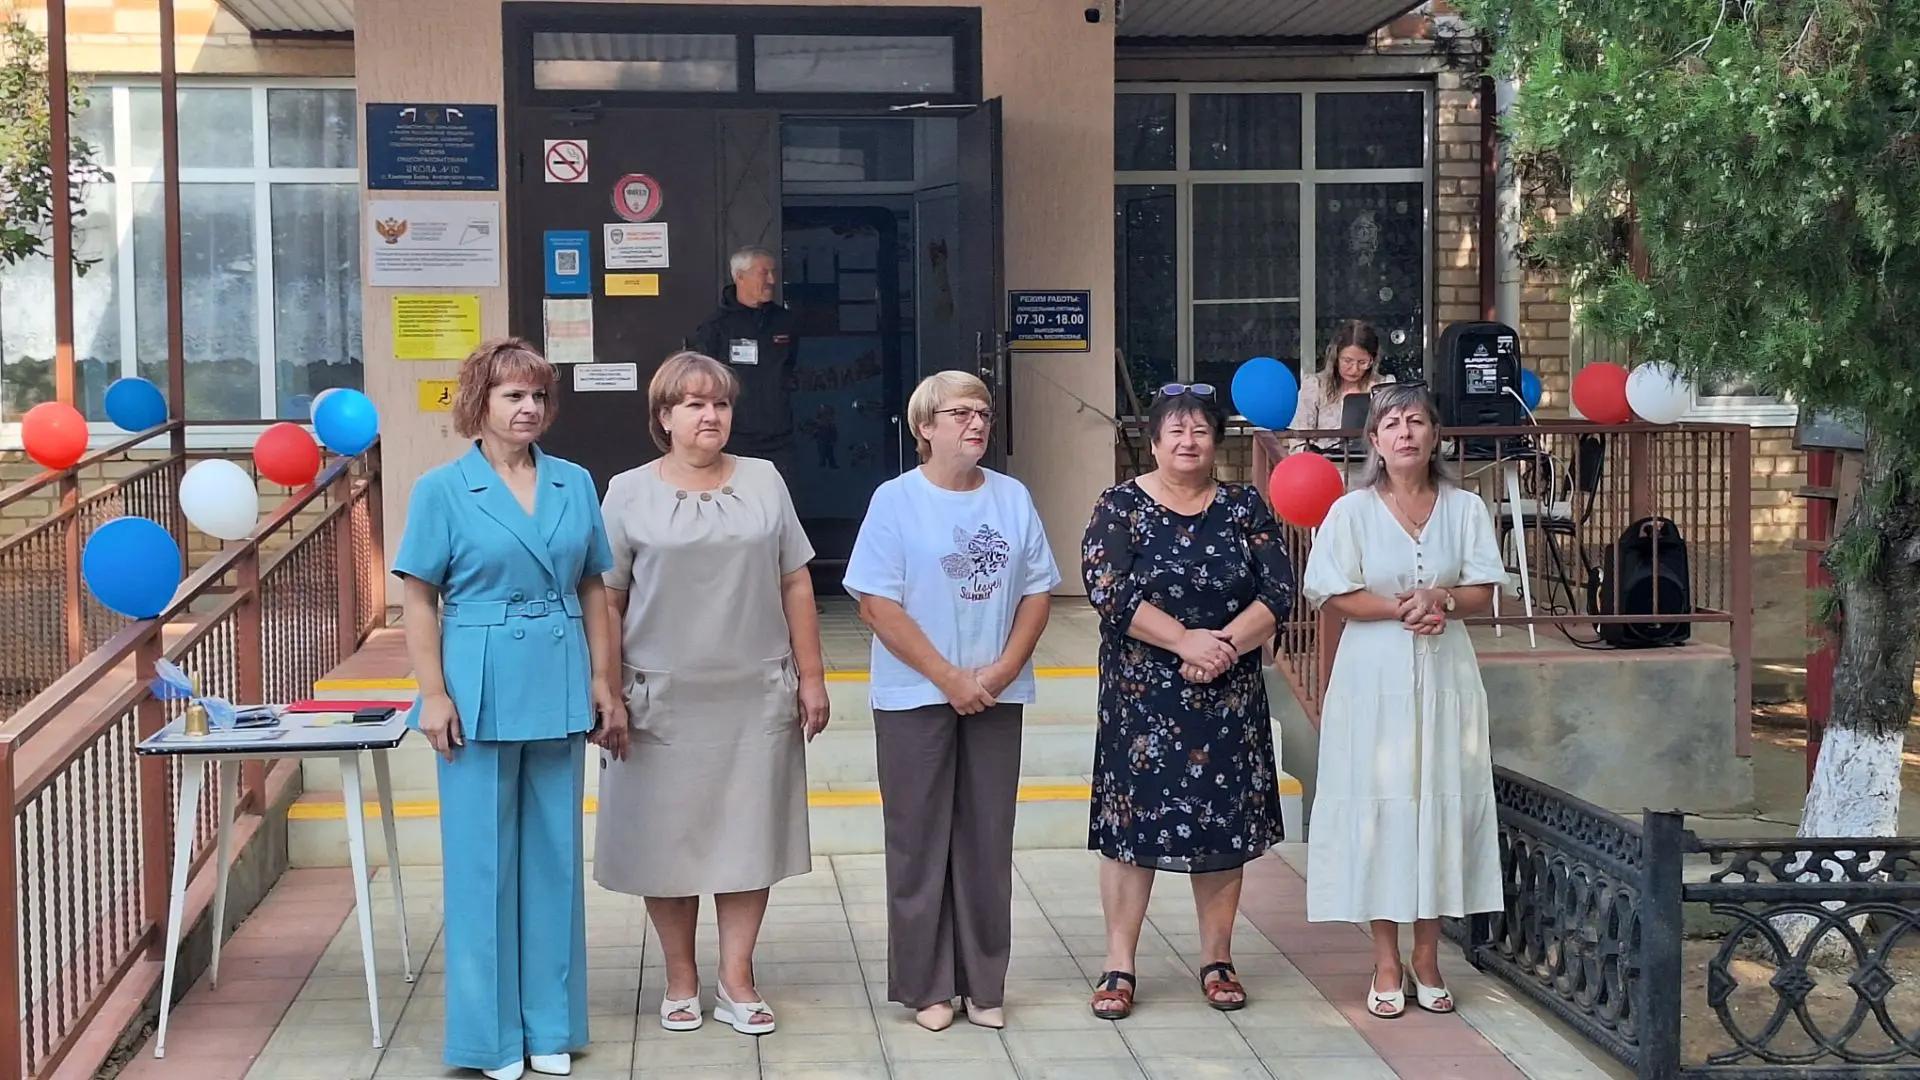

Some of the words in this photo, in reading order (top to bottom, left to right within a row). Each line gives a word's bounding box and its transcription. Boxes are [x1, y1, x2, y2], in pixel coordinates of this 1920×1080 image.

[405, 165, 437, 173] ШКОЛА
[1020, 295, 1046, 303] РЕЖИМ
[1016, 314, 1045, 324] 07.30
[1055, 314, 1084, 324] 18.00
